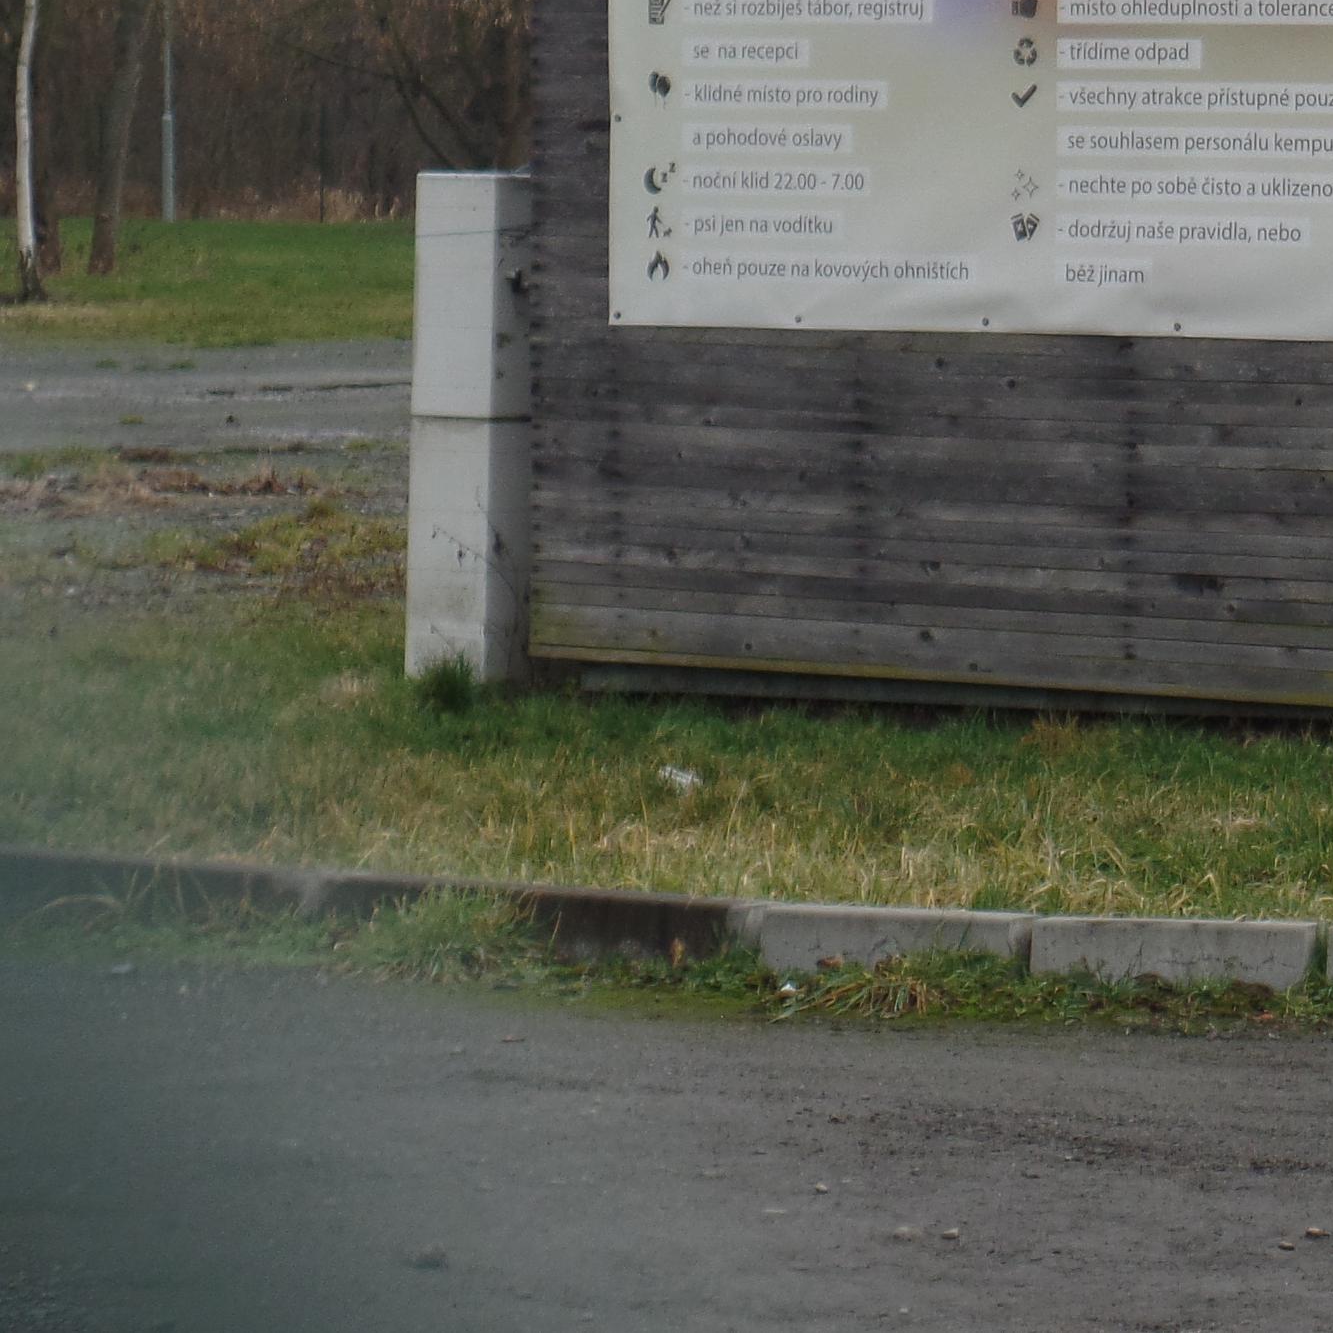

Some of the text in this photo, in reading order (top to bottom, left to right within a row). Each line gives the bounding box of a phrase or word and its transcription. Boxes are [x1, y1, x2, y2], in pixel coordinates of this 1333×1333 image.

[1243, 2, 1253, 16] a
[693, 41, 799, 64] se na recepci
[1069, 41, 1190, 65] třídíme odpad
[694, 84, 878, 108] klidné místo pro rodiny
[1068, 85, 1137, 110] všechny
[1141, 87, 1202, 106] atrakce
[1206, 86, 1290, 112] přístupné
[692, 128, 842, 149] a pohodové oslavy
[1066, 131, 1333, 156] se souhlasem personálu kempu
[692, 170, 865, 191] noční klid 22.00 7.00
[1068, 175, 1333, 199] nechte po sobě čisto a uklizeno
[693, 216, 833, 236] psi jen na vodítku
[1068, 219, 1302, 244] dodržuj naše pravidla, nebo
[692, 257, 969, 282] oheň pouze na kovových ohništích
[1065, 264, 1145, 288] běž jinam
